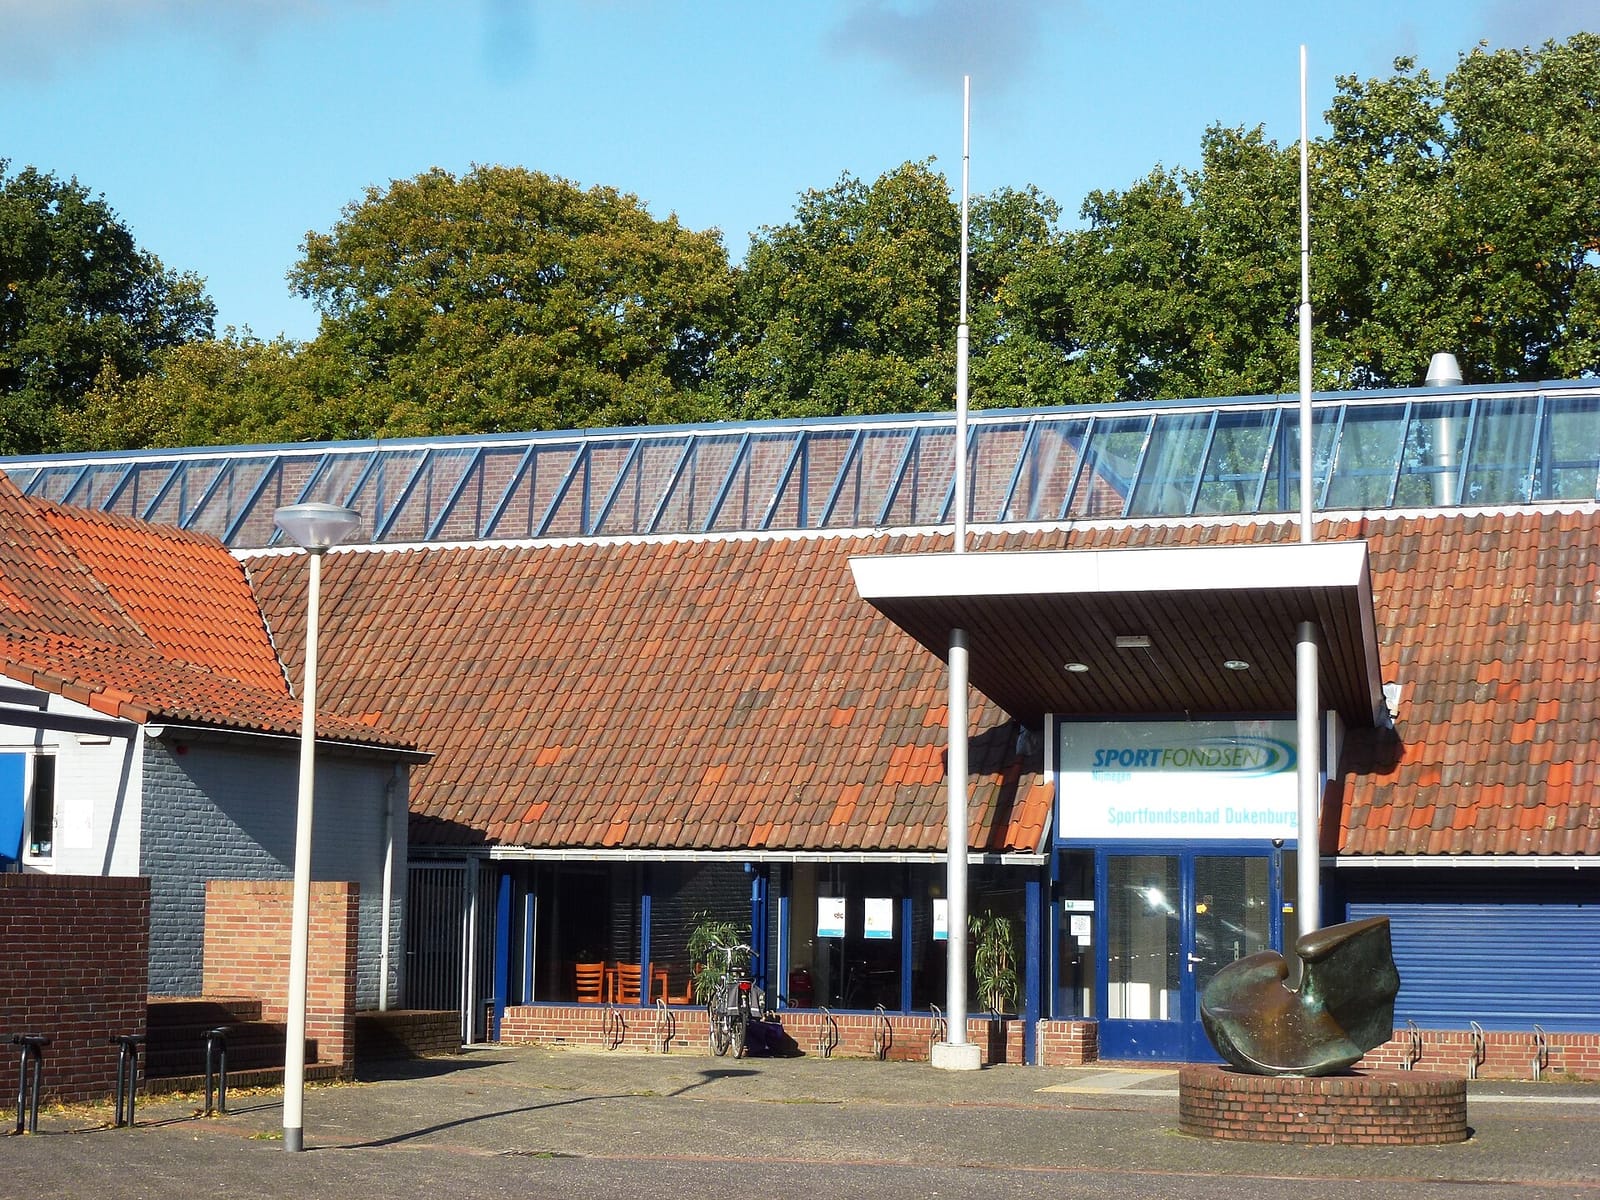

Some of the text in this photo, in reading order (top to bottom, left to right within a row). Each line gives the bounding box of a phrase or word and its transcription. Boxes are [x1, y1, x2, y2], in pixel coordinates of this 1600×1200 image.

[1092, 748, 1261, 768] SPORTFONDSEN
[1108, 807, 1298, 827] Sportfondsenbad Dukenburg
